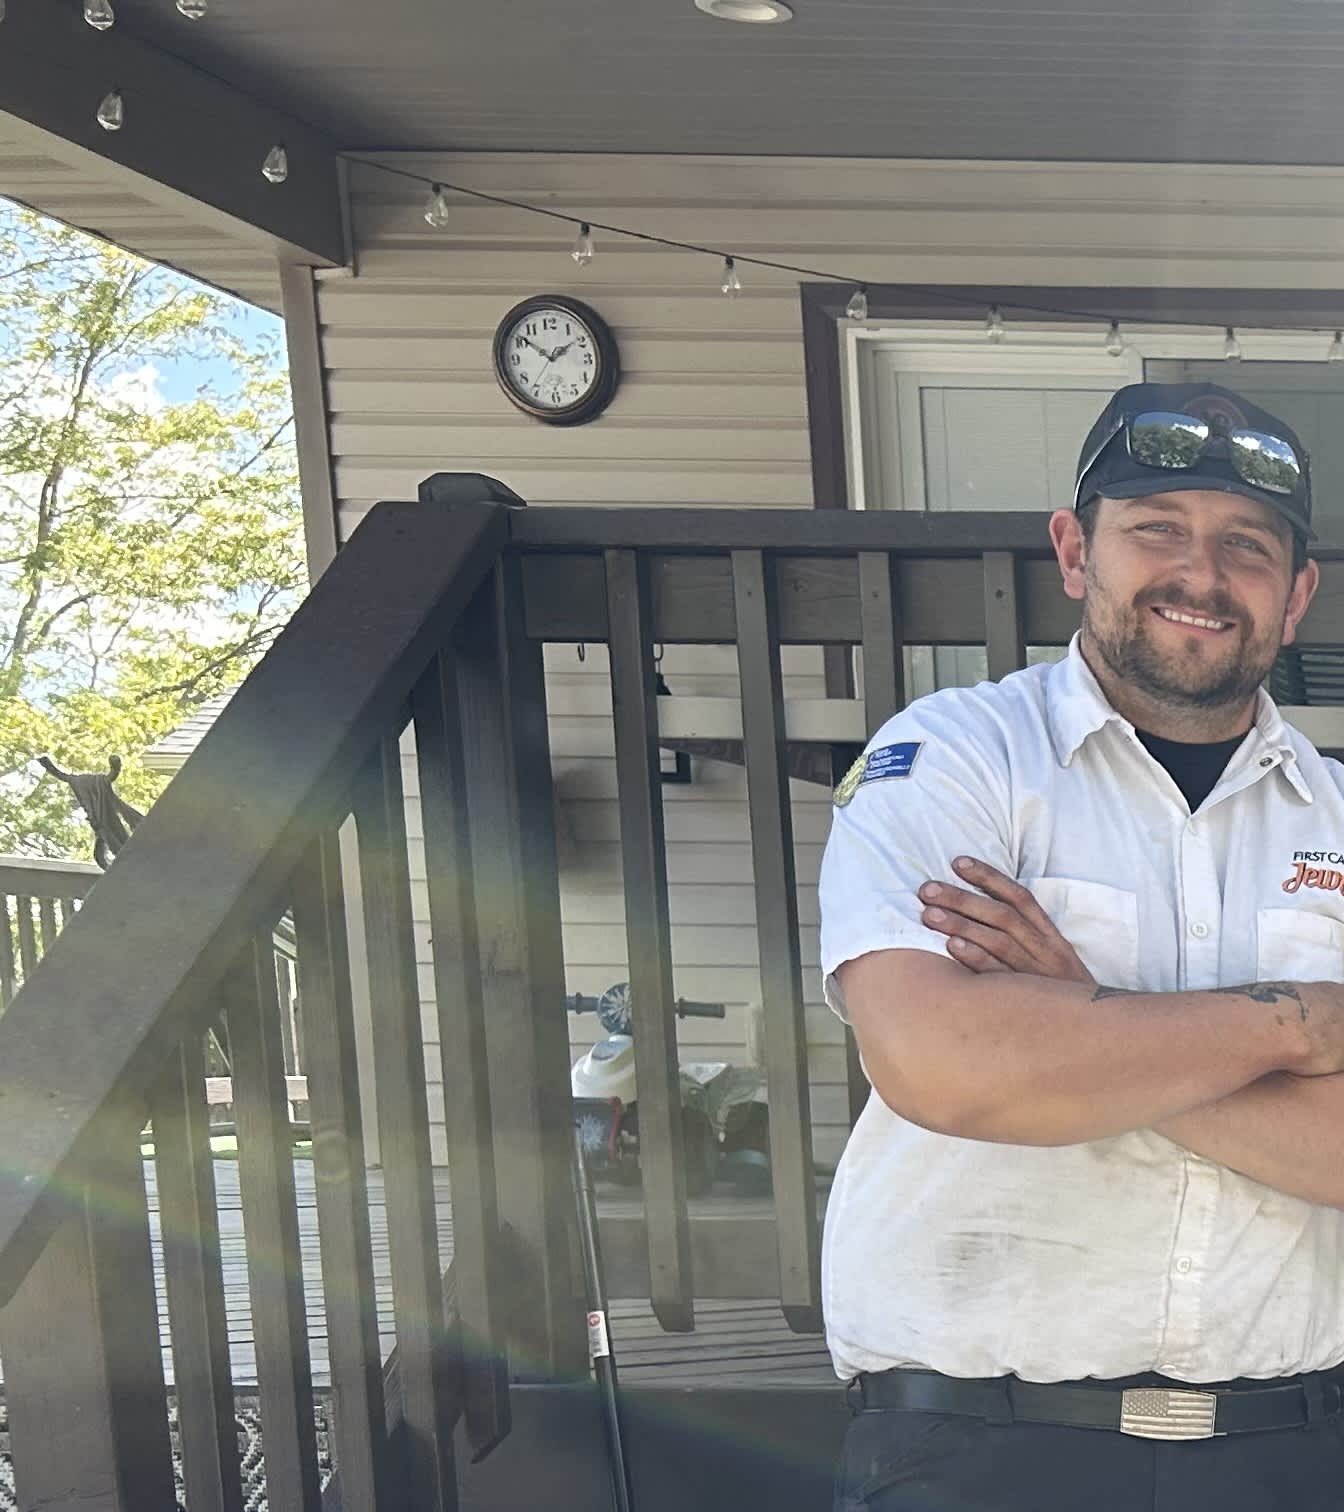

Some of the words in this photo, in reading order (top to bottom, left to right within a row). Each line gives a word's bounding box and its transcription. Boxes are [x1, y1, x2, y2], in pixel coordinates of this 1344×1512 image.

[526, 323, 537, 336] 11
[543, 317, 557, 331] 12
[577, 335, 586, 349] 2
[511, 353, 520, 366] 9
[583, 352, 593, 365] 3
[519, 371, 528, 385] 8
[1293, 851, 1327, 863] FIRST
